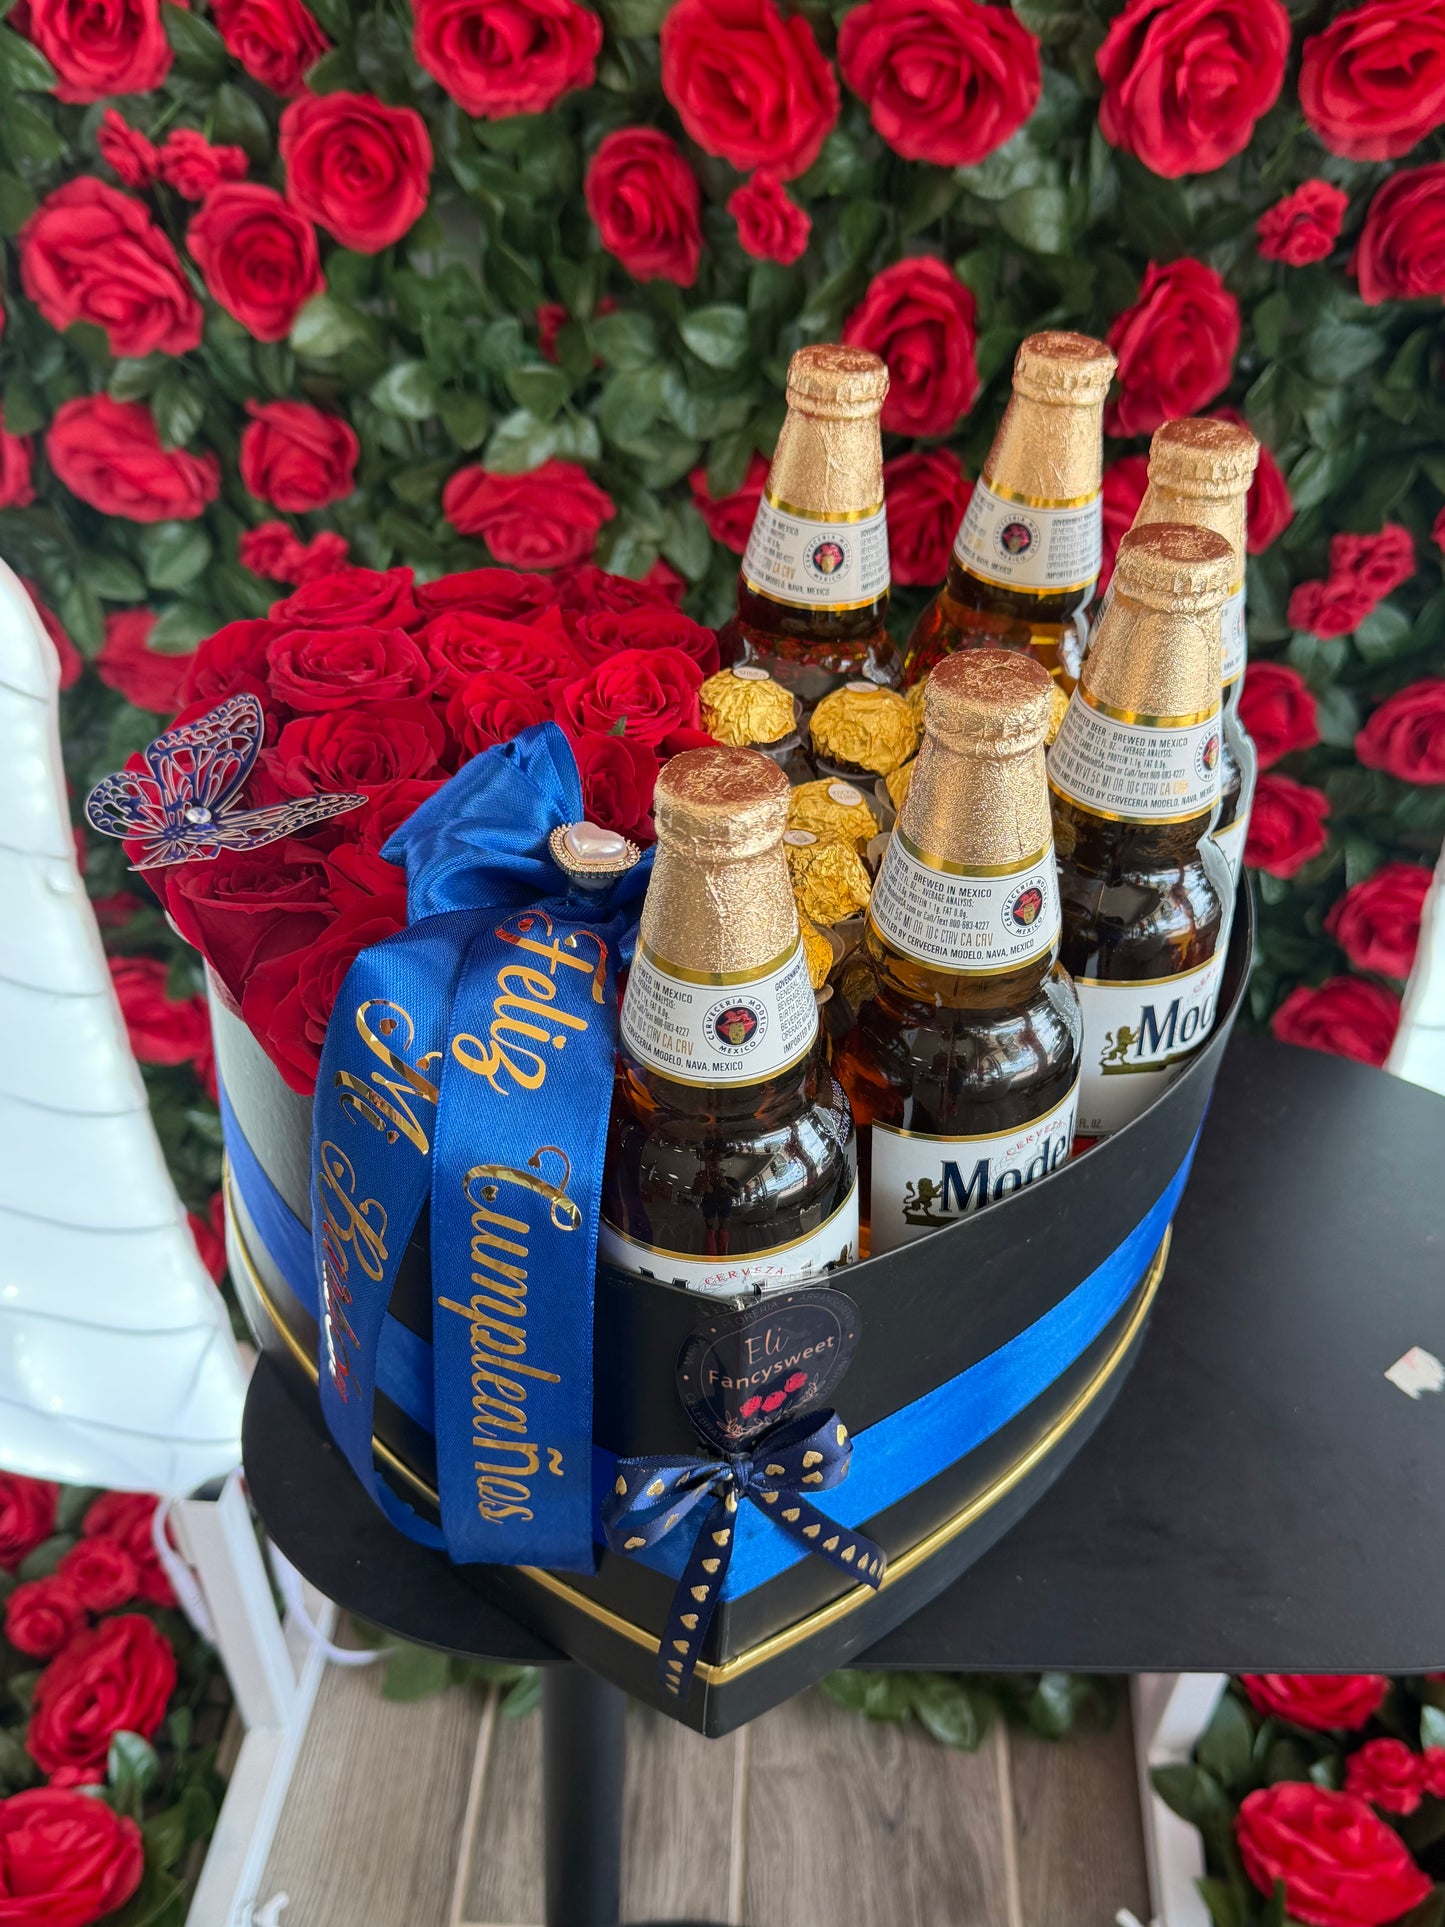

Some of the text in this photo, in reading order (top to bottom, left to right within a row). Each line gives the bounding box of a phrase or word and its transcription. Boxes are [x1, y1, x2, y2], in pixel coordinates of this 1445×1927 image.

[1091, 722, 1107, 736] BEER
[1113, 732, 1146, 747] BREWED
[1148, 739, 1157, 748] IN
[1160, 737, 1188, 748] MEXICO
[1071, 777, 1095, 797] BOTTLED
[1106, 793, 1148, 809] CERVECERIA
[1160, 782, 1171, 796] CA
[897, 857, 992, 898] BEER BREWED IN MEXICO
[908, 891, 927, 908] PROTEIN
[942, 906, 953, 916] FAT
[922, 888, 945, 903] AVERAGE
[946, 895, 975, 908] ANALYSIS:
[1003, 880, 1034, 927] CERVECERIA
[898, 928, 907, 940] BY
[907, 934, 948, 957] CERVECERIA
[1010, 939, 1035, 955] MEXICO
[940, 929, 958, 946] CTRV
[960, 932, 972, 947] CA
[975, 932, 994, 947] CRV
[1015, 917, 1043, 935] MEXICO
[654, 979, 660, 991] IN
[662, 985, 693, 1004] MEXICO
[705, 998, 743, 1041] CERVECERIA
[747, 999, 767, 1035] MODELO
[1134, 982, 1217, 1058] Mod
[626, 1021, 652, 1053] CERVECERIA
[712, 1060, 743, 1072] MEXICO
[662, 1032, 673, 1051] CA
[675, 1038, 694, 1056] CRV
[718, 1040, 757, 1055] MEXICO
[334, 998, 442, 1155] Mi
[1006, 1118, 1063, 1156] CERVEZA
[939, 1107, 1075, 1213] Model
[438, 910, 608, 1525] Feliz Cumpleaños
[704, 1266, 784, 1286] CERVEZA
[708, 1335, 835, 1391] Fancysweet
[745, 1327, 790, 1365] Eli
